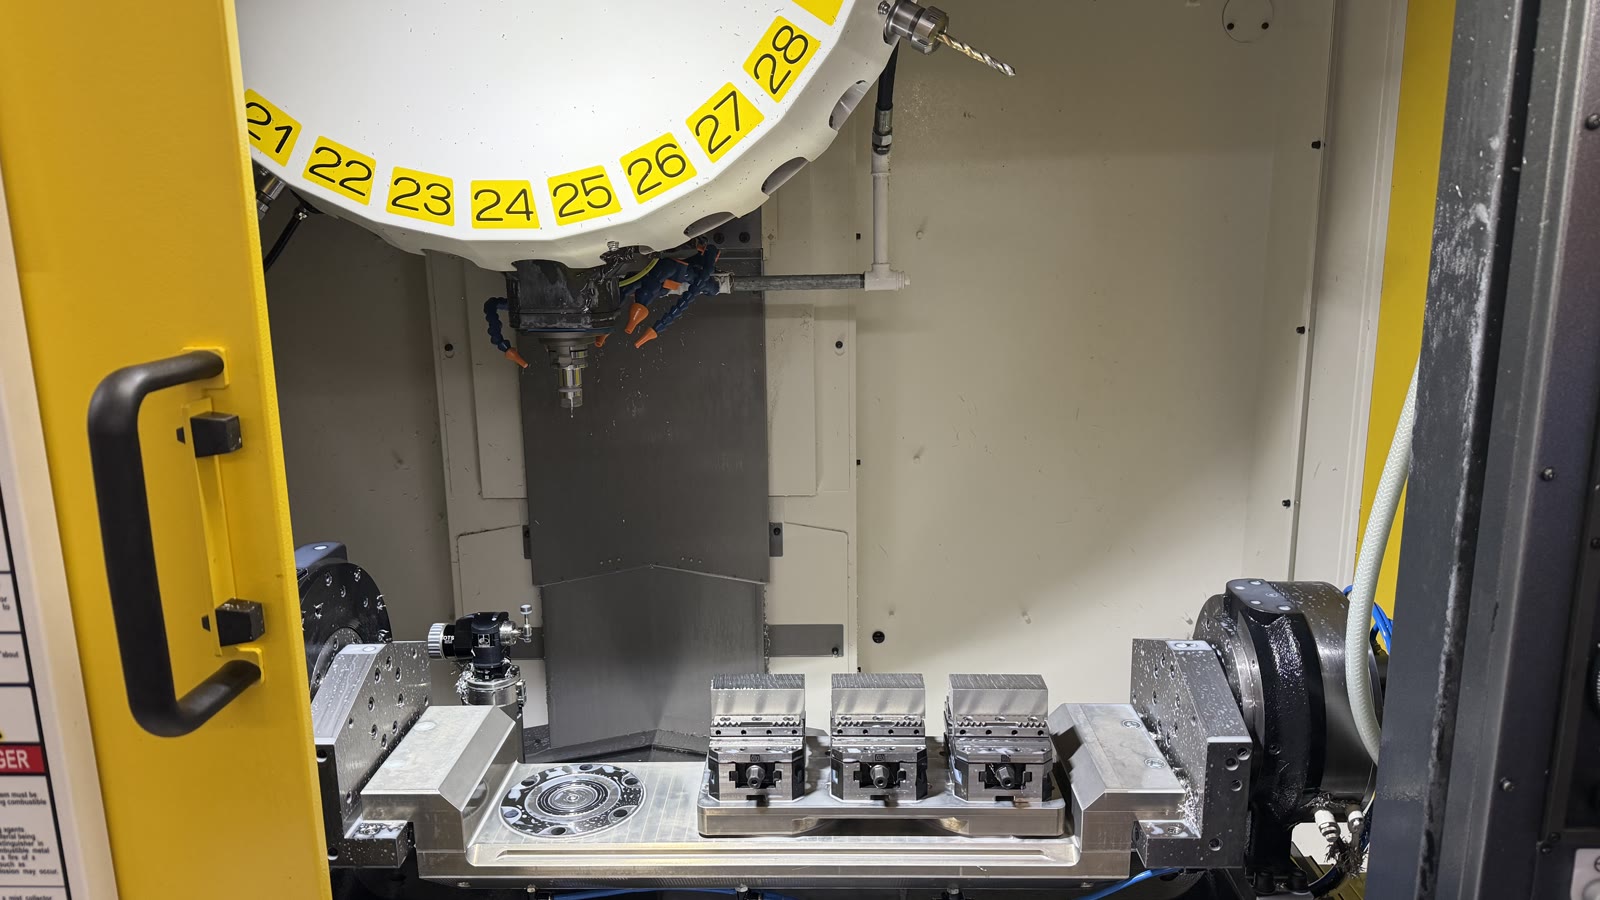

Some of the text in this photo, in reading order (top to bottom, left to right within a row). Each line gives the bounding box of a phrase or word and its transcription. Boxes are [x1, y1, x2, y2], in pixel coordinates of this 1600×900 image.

[753, 25, 809, 95] 28
[246, 102, 293, 154] 21
[695, 90, 740, 155] 27
[308, 146, 372, 197] 22
[627, 143, 686, 196] 26
[391, 176, 451, 216] 23
[474, 188, 534, 222] 24
[553, 173, 612, 218] 25
